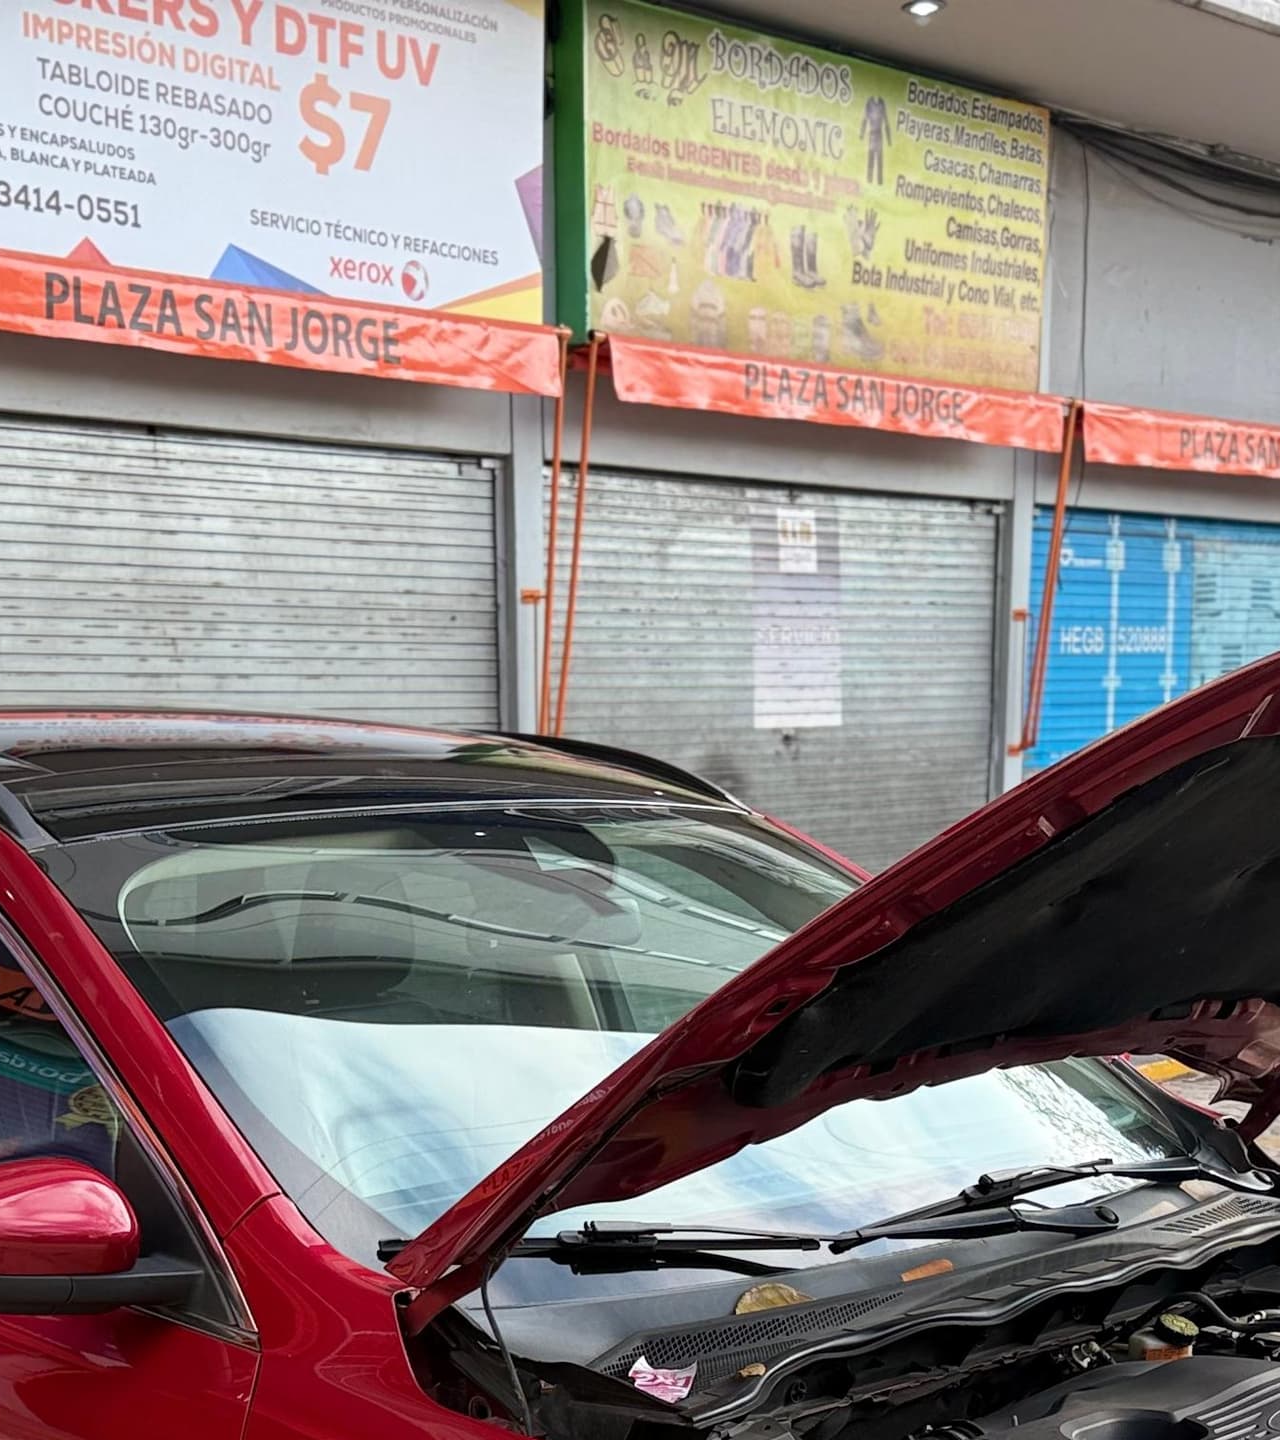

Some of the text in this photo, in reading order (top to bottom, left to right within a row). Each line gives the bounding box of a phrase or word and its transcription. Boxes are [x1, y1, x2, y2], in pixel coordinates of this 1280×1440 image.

[21, 10, 281, 92] IMPRESIÓN DIGITAL
[275, 5, 365, 69] DTF
[376, 29, 440, 87] UV
[389, 12, 476, 44] PROMOCIONALES
[36, 57, 272, 124] TABLOIDE REBASADO
[708, 28, 852, 104] BORDADOS
[6, 125, 18, 138] Y
[20, 128, 135, 160] ENCAPSALUDOS
[38, 94, 272, 162] COUCHÉ 130gr-300gr
[298, 72, 391, 175] $7
[592, 121, 670, 157] Bordados
[675, 138, 762, 178] URGENTES
[10, 144, 69, 170] BLANCA
[71, 158, 82, 172] Y
[84, 160, 157, 186] PLATEADA
[250, 208, 499, 266] SERVICIO TÉCNICO Y REFACCIONES
[904, 238, 1041, 288] Uniformes Industriales,
[330, 256, 394, 287] xerox
[852, 262, 882, 288] Bota
[885, 266, 944, 298] Industrial
[946, 283, 956, 305] y
[958, 280, 989, 305] Cono
[43, 272, 402, 364] PLAZA SAN JORGE
[744, 363, 964, 424] PLAZA SAN JORGE
[1179, 428, 1238, 462] PLAZA
[1244, 438, 1280, 467] SAN
[1060, 626, 1104, 655] HEGB
